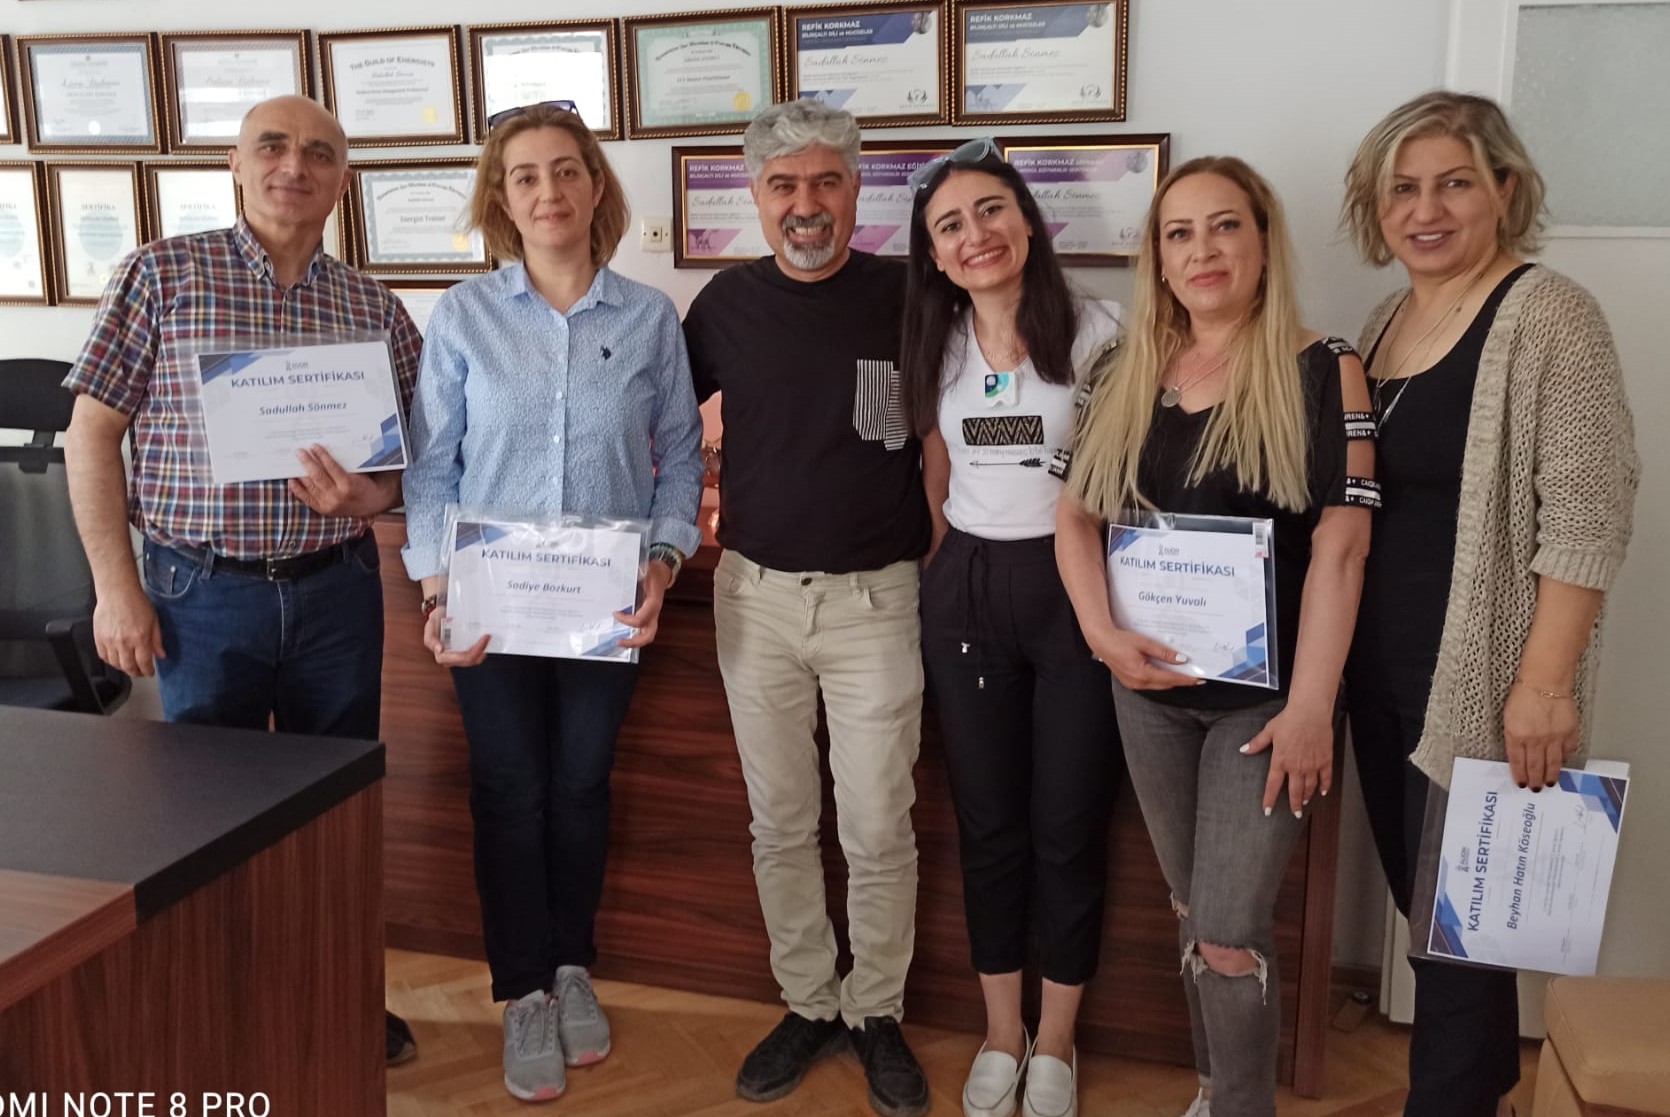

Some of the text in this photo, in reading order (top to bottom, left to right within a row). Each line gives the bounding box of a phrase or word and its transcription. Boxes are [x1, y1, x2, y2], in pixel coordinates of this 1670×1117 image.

[802, 20, 860, 31] REFİK KORKMAZ
[231, 370, 365, 388] KATILIM SERTİFİKASI
[259, 403, 305, 416] Sadullah
[481, 548, 611, 568] KATILIM SERTİFİKASI
[1120, 556, 1236, 577] KATILIM SERTİFİKASI
[506, 580, 582, 596] Sadiye Bozkurt
[1138, 590, 1173, 605] Gökçen
[1467, 791, 1498, 932] KATILIM SERTİFİKASI
[1506, 888, 1522, 930] Beyhan
[1517, 802, 1537, 854] Köseoğlu
